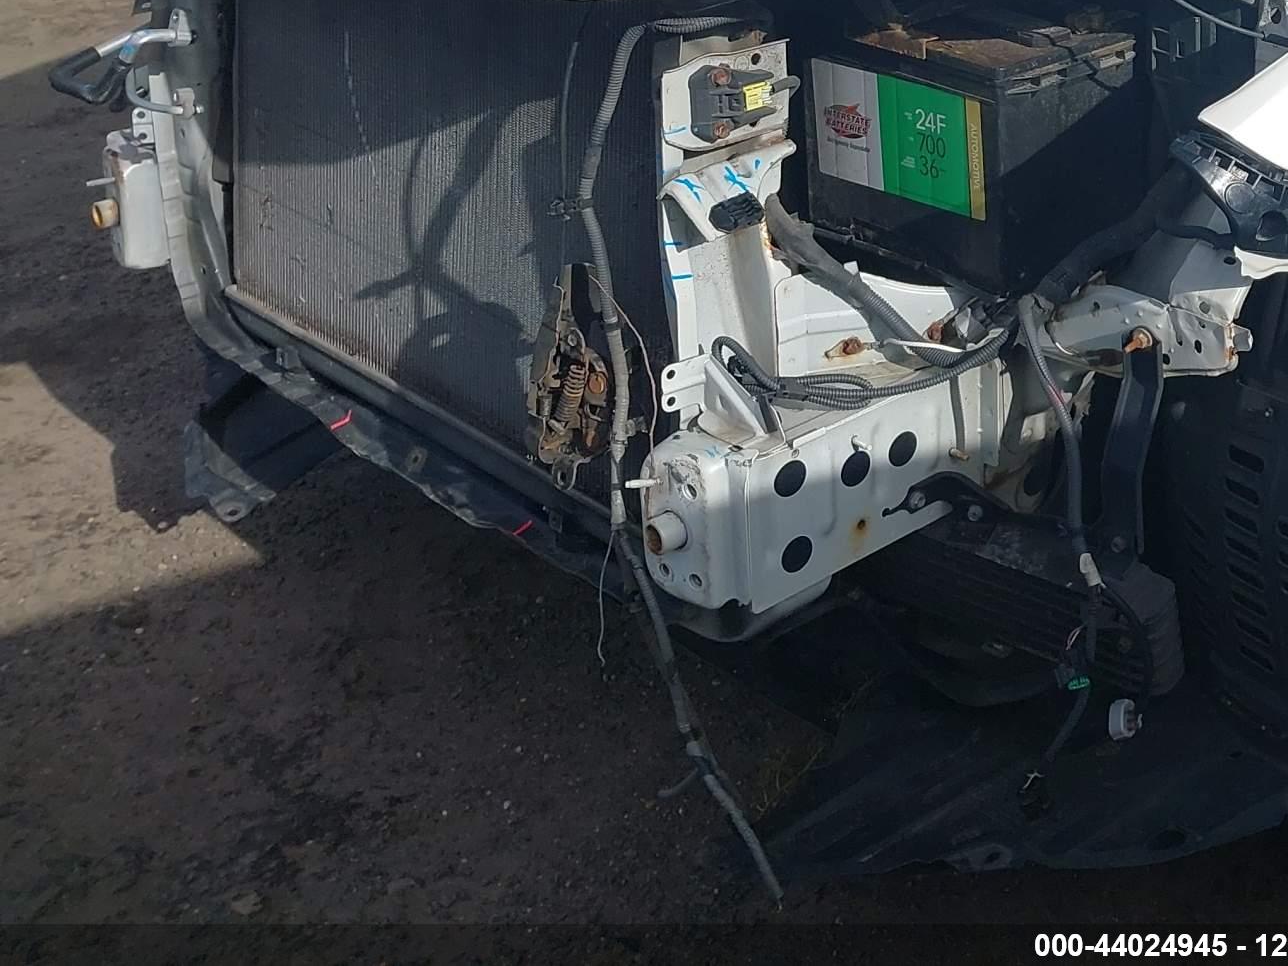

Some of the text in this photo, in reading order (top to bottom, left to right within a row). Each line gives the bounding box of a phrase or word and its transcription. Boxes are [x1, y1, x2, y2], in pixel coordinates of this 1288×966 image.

[824, 106, 870, 127] INTERSTATE
[825, 117, 868, 135] BATTERIES
[915, 108, 947, 134] 24F
[916, 132, 946, 159] 700
[969, 122, 982, 190] AUTOMOTIVE
[920, 155, 940, 179] 36
